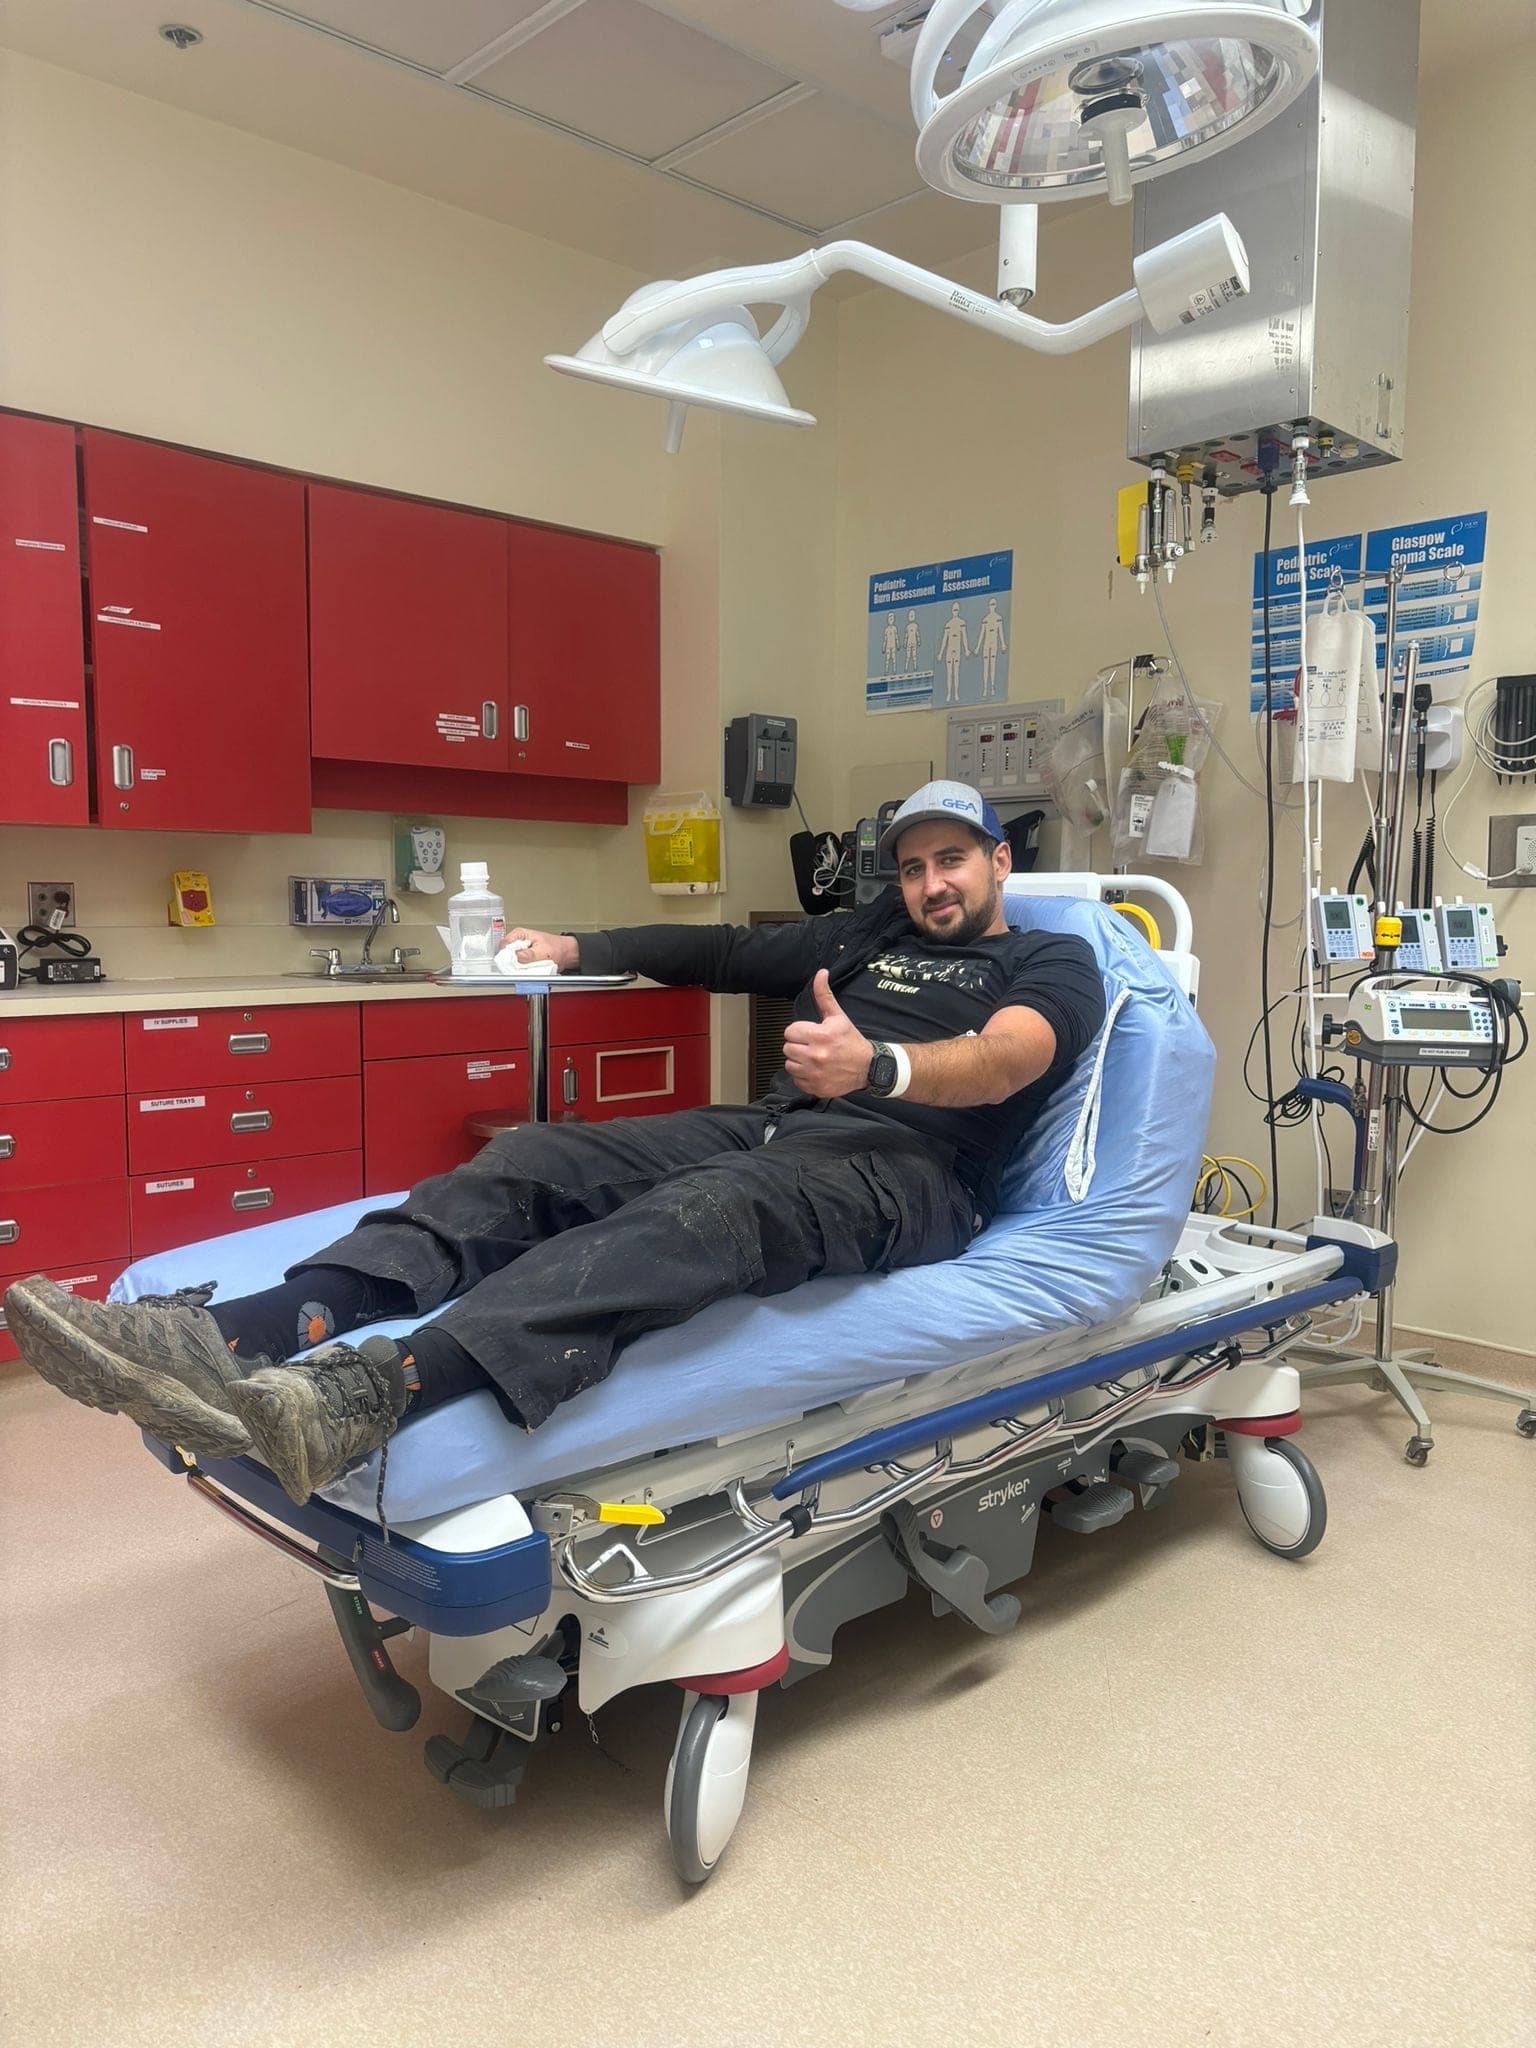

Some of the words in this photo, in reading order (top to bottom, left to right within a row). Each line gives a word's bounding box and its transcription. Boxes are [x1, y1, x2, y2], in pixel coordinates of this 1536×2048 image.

[1391, 532, 1445, 551] Glasgow
[1391, 550, 1426, 566] Coma
[1428, 543, 1464, 560] Scale
[943, 569, 962, 580] Burn
[1276, 573, 1307, 585] Com
[874, 578, 906, 592] Pediatric
[942, 575, 990, 593] Assessment
[873, 594, 891, 604] Burn
[891, 585, 936, 601] Assessment
[942, 798, 978, 814] GEA
[877, 979, 921, 994] LIFTWEAR
[156, 1180, 185, 1188] SUTURES
[978, 1478, 1030, 1512] stryker
